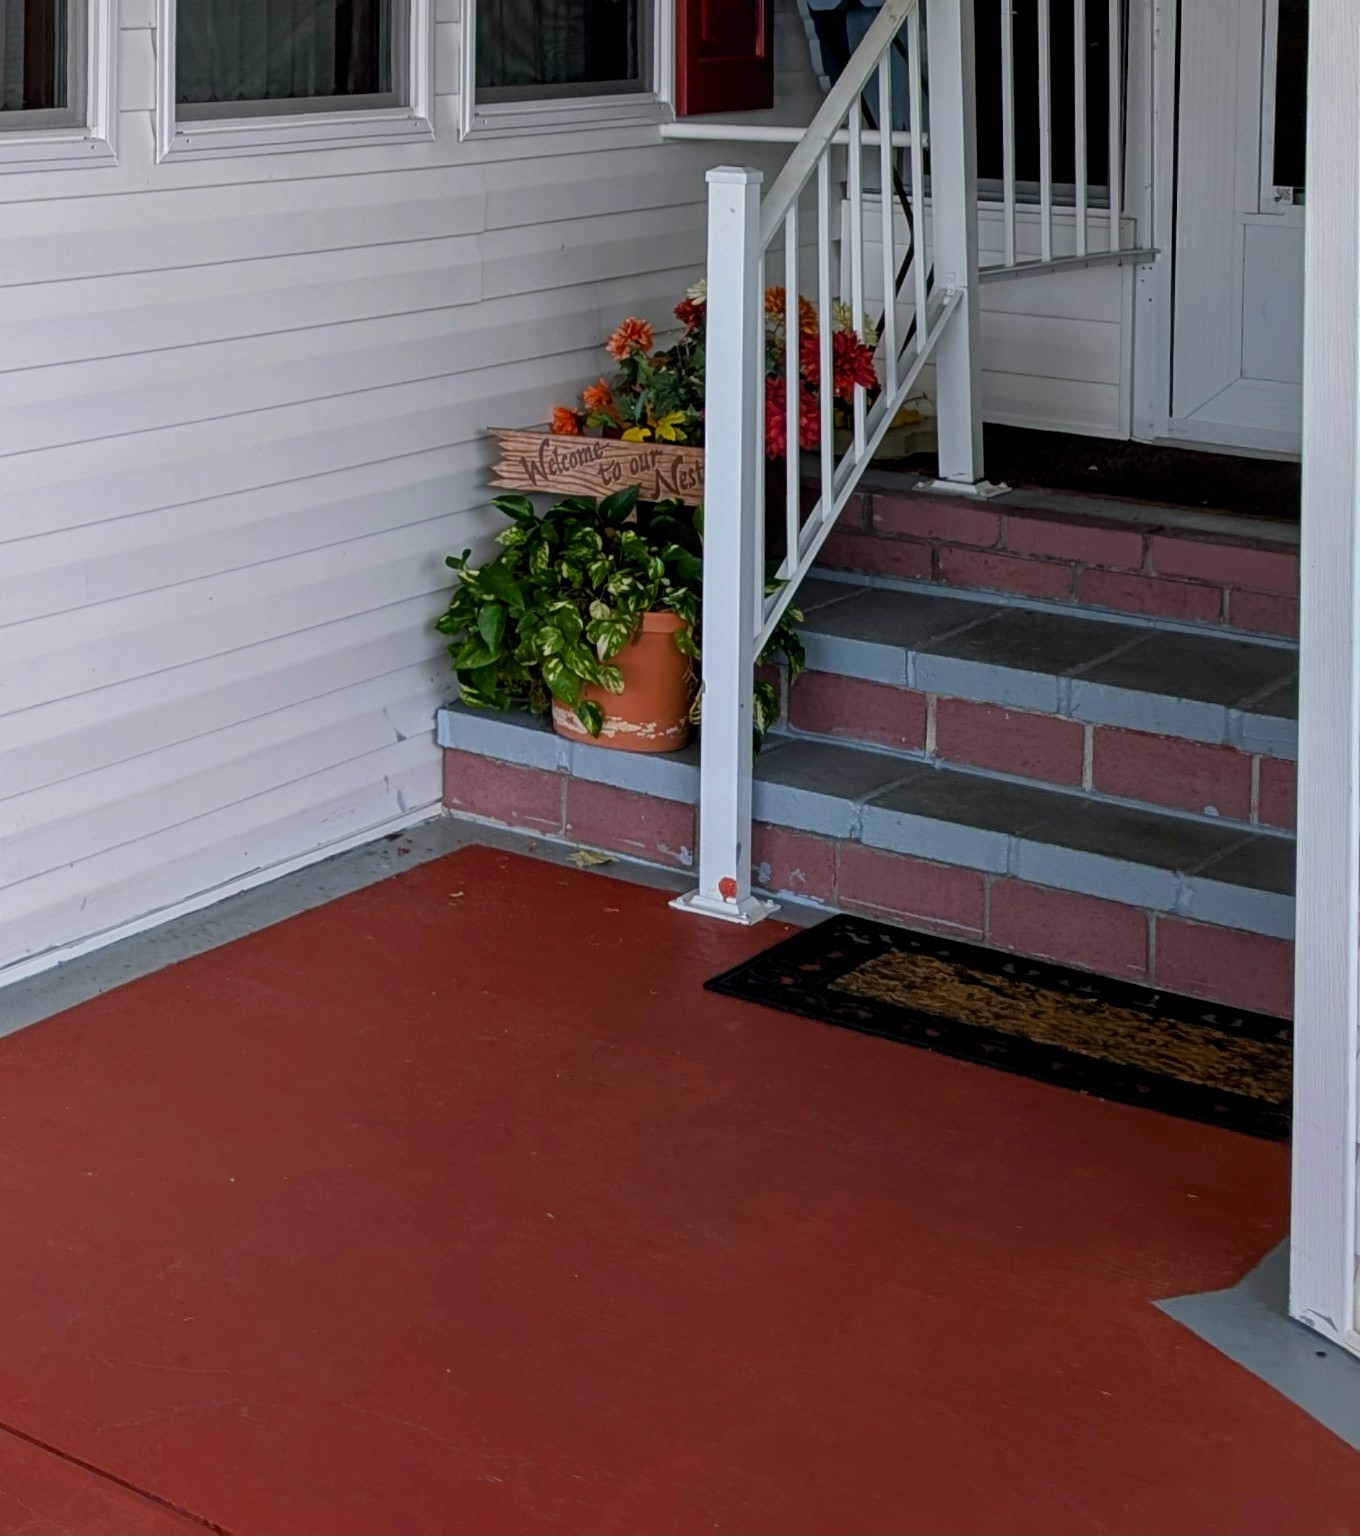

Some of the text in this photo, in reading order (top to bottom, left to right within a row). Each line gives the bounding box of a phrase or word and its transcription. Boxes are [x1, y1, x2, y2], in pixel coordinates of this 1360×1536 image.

[519, 438, 705, 500] Welcome to our Nest
